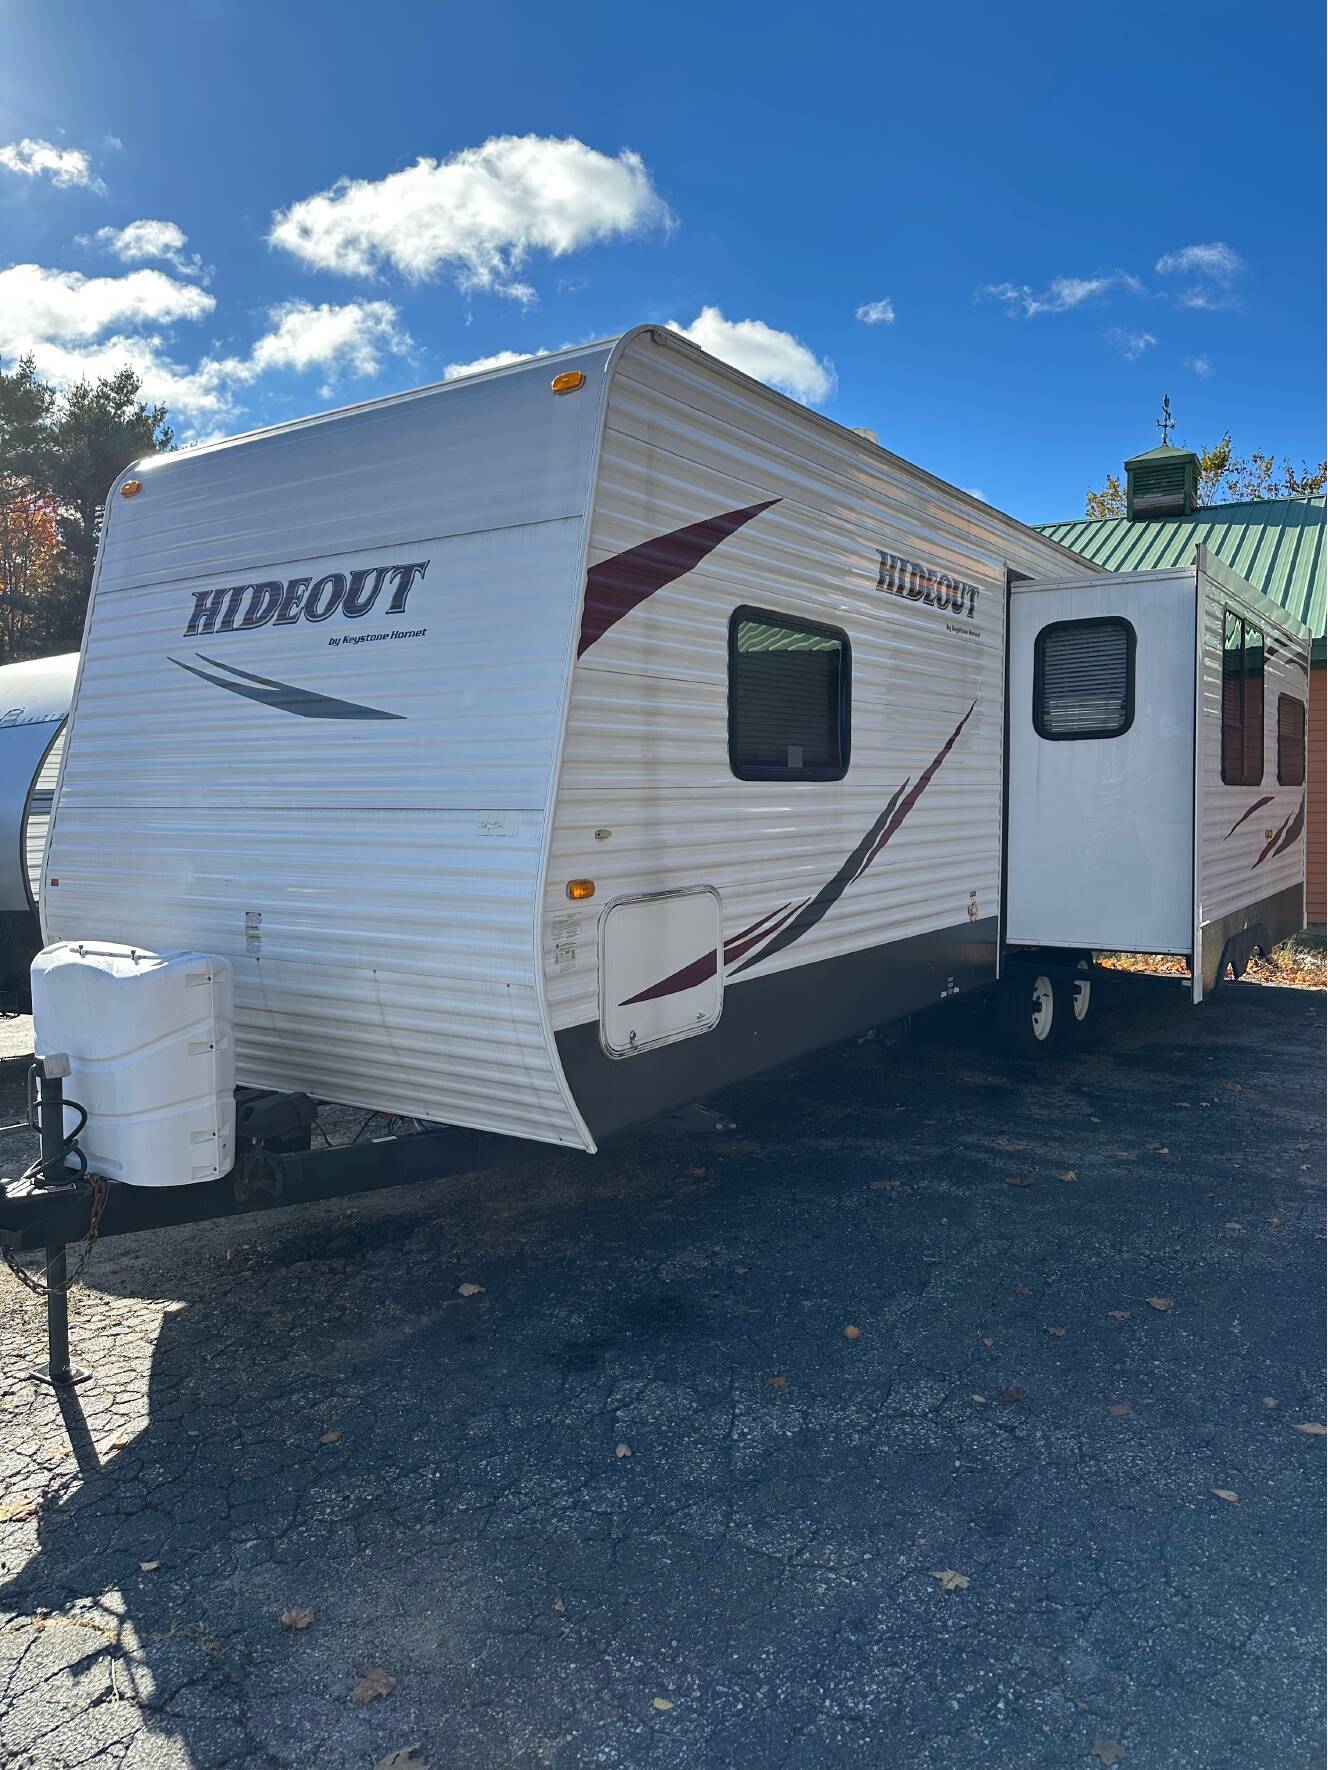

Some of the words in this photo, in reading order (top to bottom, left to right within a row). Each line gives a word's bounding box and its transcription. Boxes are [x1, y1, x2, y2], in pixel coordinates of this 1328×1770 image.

[183, 560, 431, 637] HIDEOUT
[876, 548, 980, 619] HIDEOUT
[328, 637, 341, 647] by
[342, 633, 390, 645] Keystone
[390, 628, 428, 640] Hornet
